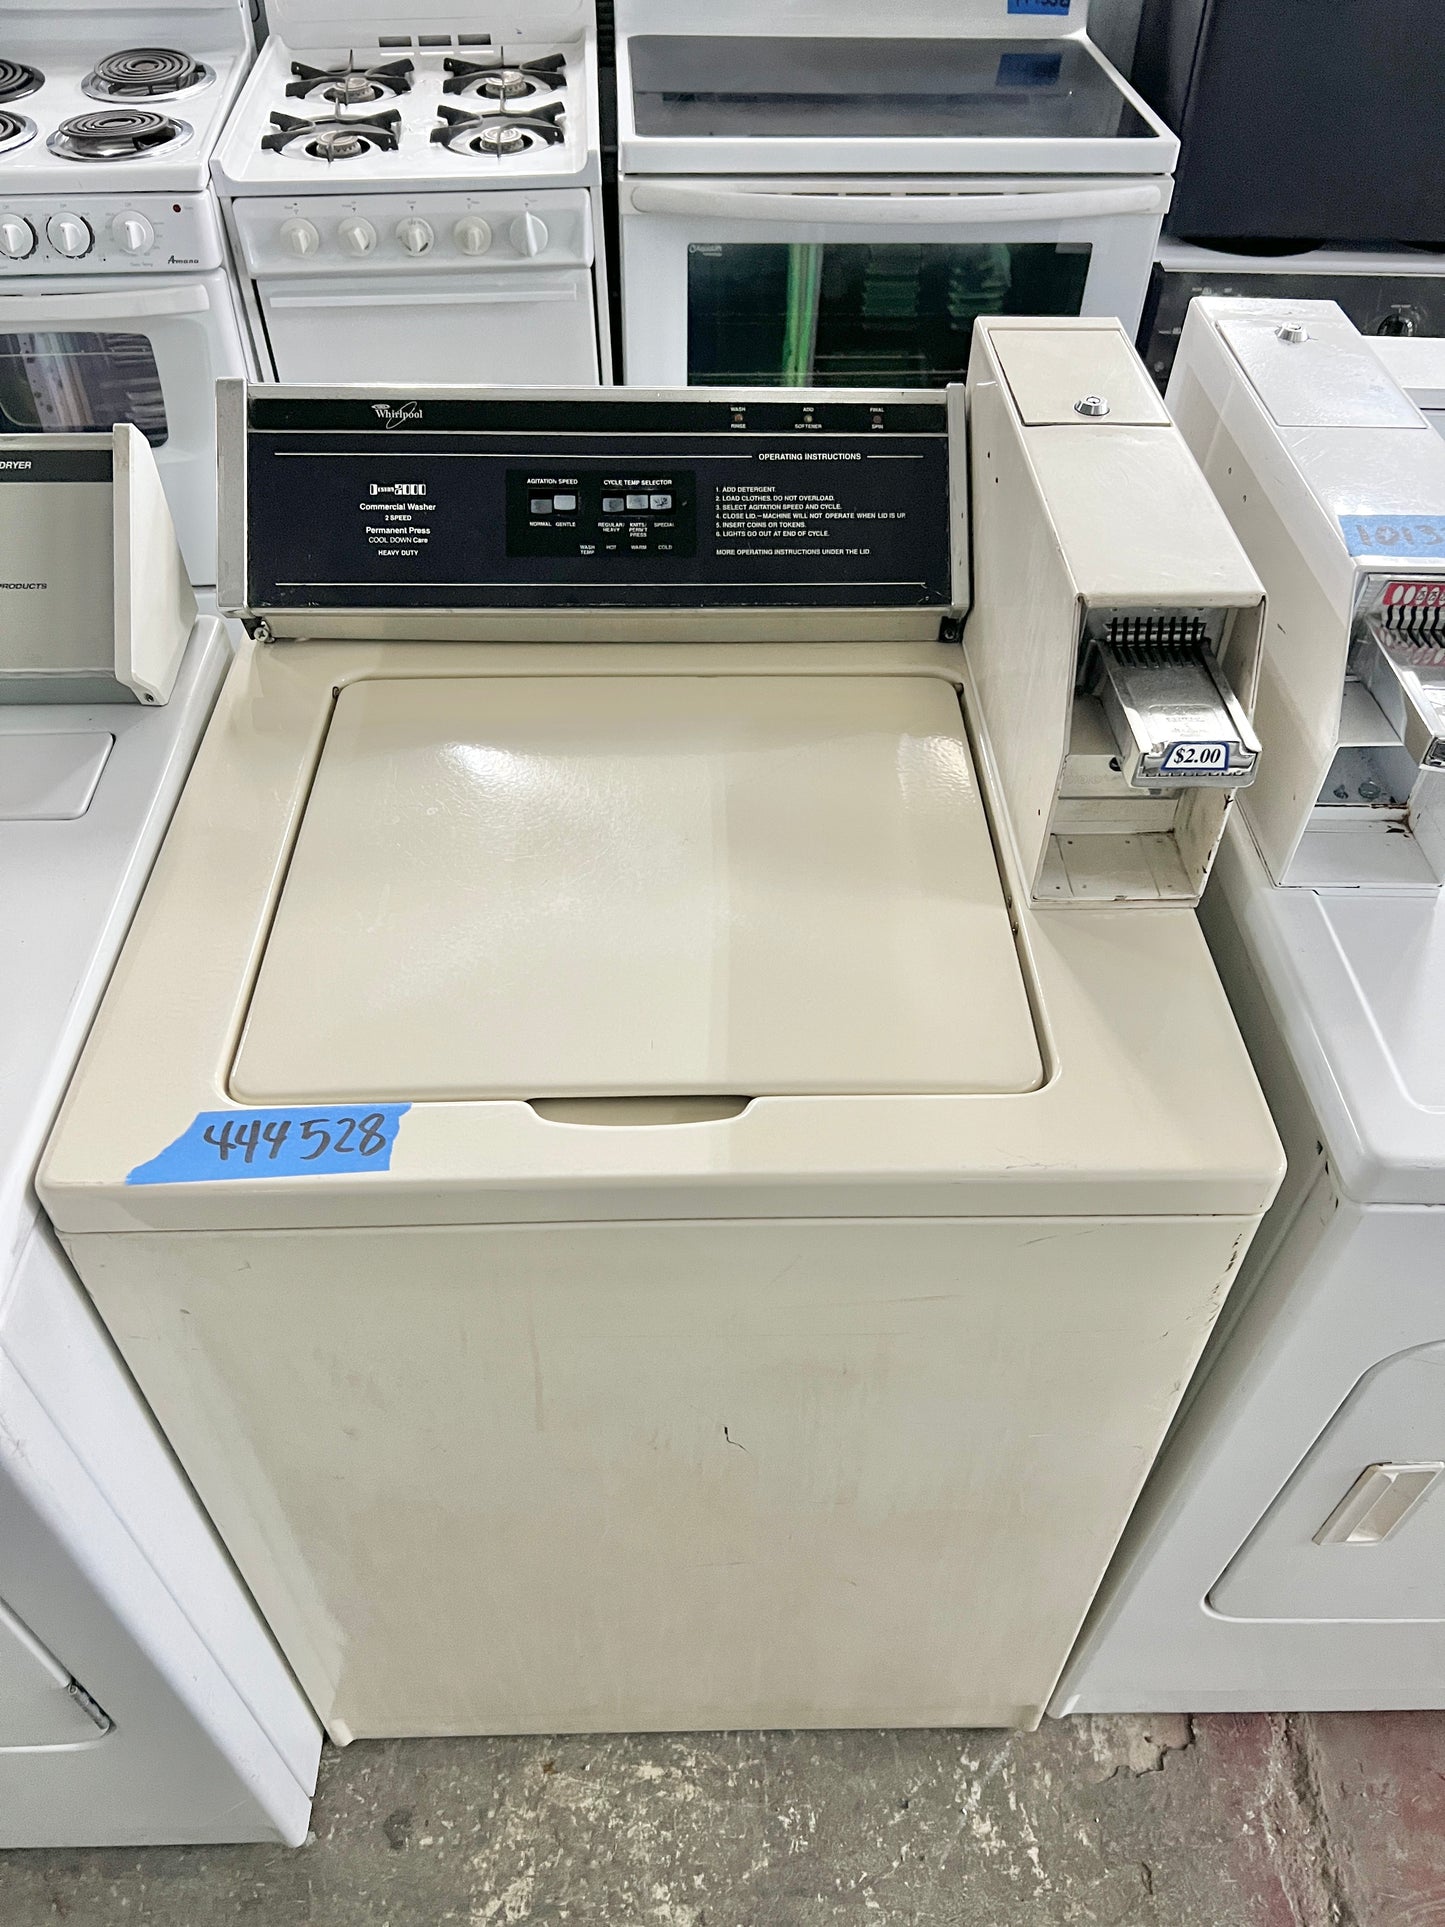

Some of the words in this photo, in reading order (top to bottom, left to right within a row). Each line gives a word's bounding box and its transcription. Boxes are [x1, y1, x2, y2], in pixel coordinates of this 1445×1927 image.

[167, 255, 199, 264] Amana
[375, 409, 423, 420] Whirlpool
[0, 461, 32, 469] DRYER
[1356, 524, 1445, 546] 1013
[1174, 747, 1222, 764] $2.00
